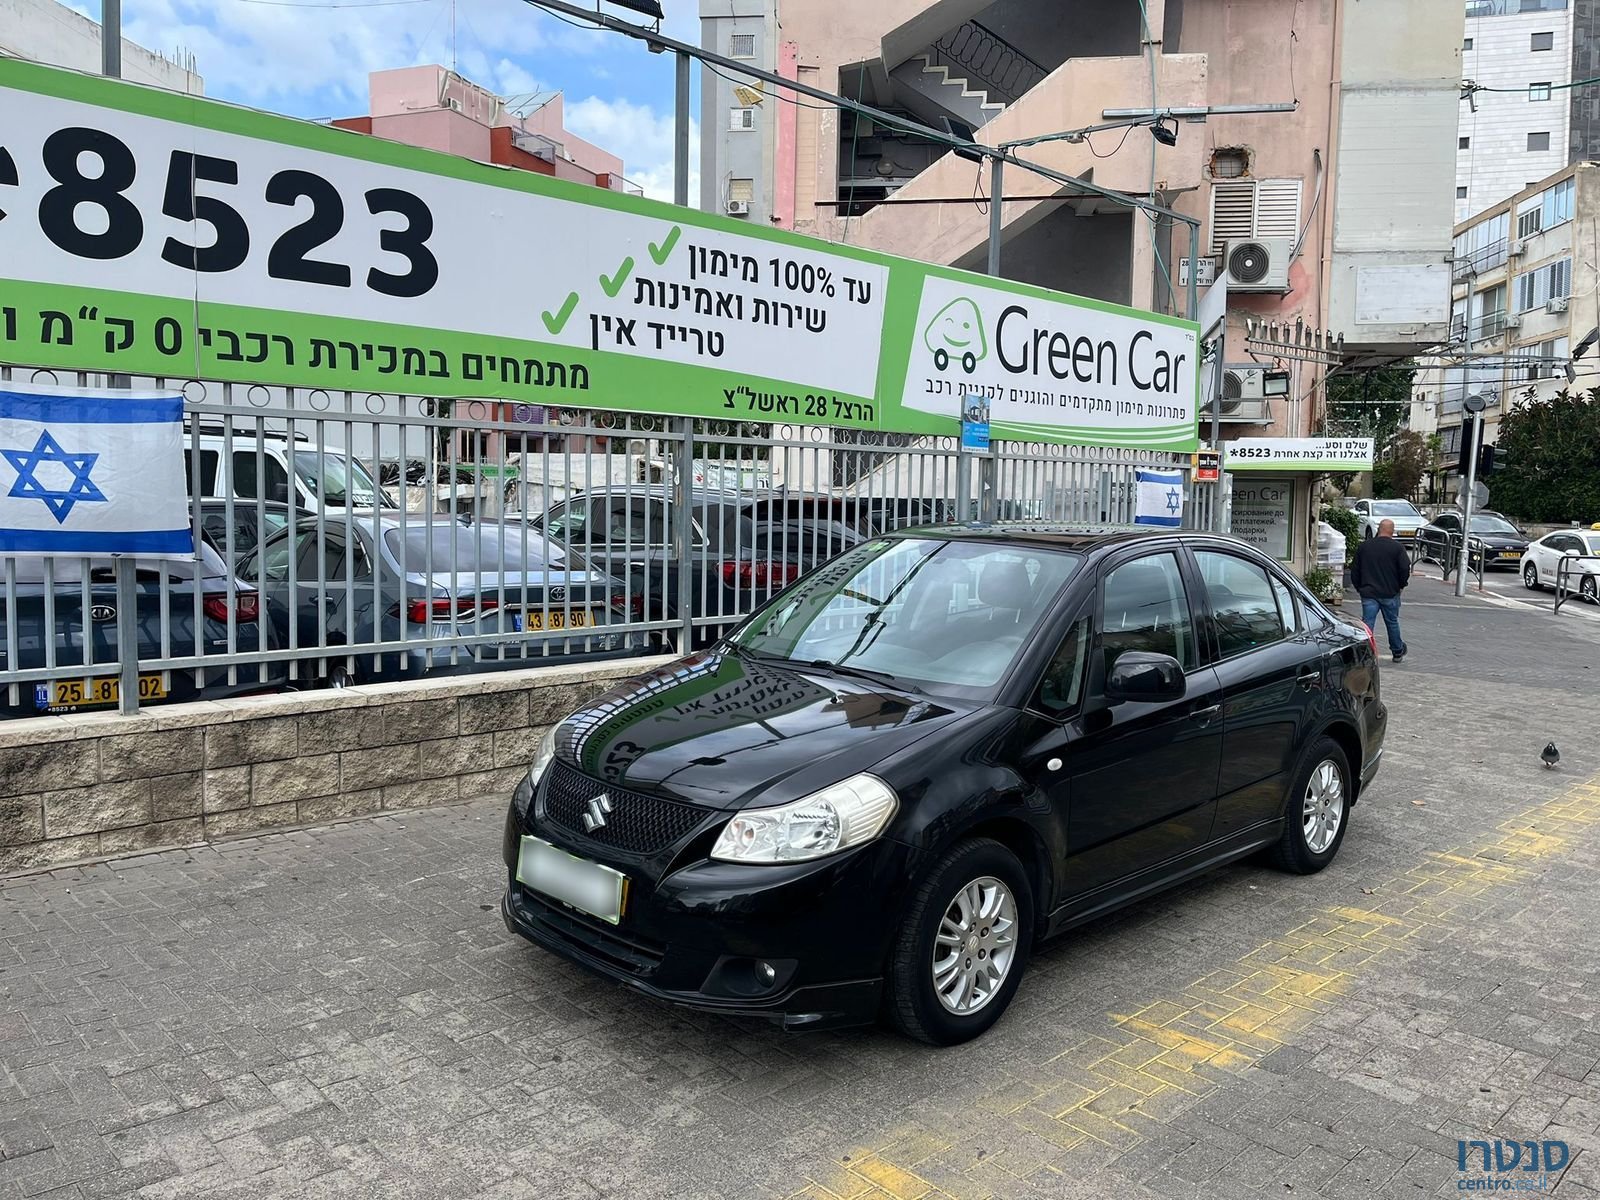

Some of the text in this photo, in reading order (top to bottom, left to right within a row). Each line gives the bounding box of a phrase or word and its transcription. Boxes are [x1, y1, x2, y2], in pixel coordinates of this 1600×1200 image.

[688, 244, 871, 305] עד 100% מימון
[633, 277, 827, 333] שירות ואמינות
[154, 316, 183, 356] 0
[589, 313, 725, 358] טרייד אין
[198, 327, 295, 366] רכבי
[995, 305, 1186, 394] Green Car
[308, 338, 450, 378] במכירת
[461, 352, 589, 390] מתמחים
[925, 378, 952, 395] רכב
[804, 394, 827, 417] 28
[1010, 388, 1054, 406] והוגנים
[1059, 394, 1112, 414] מתקדמים
[832, 396, 874, 422] הרצל
[1116, 400, 1143, 417] מימון
[1146, 404, 1186, 420] פתרונות
[1273, 450, 1300, 459] אחרת
[1325, 450, 1337, 458] זה
[1339, 450, 1367, 459] אצלנו
[1345, 440, 1368, 449] שלם
[1302, 450, 1323, 460] קצת
[1232, 487, 1286, 500] een Car
